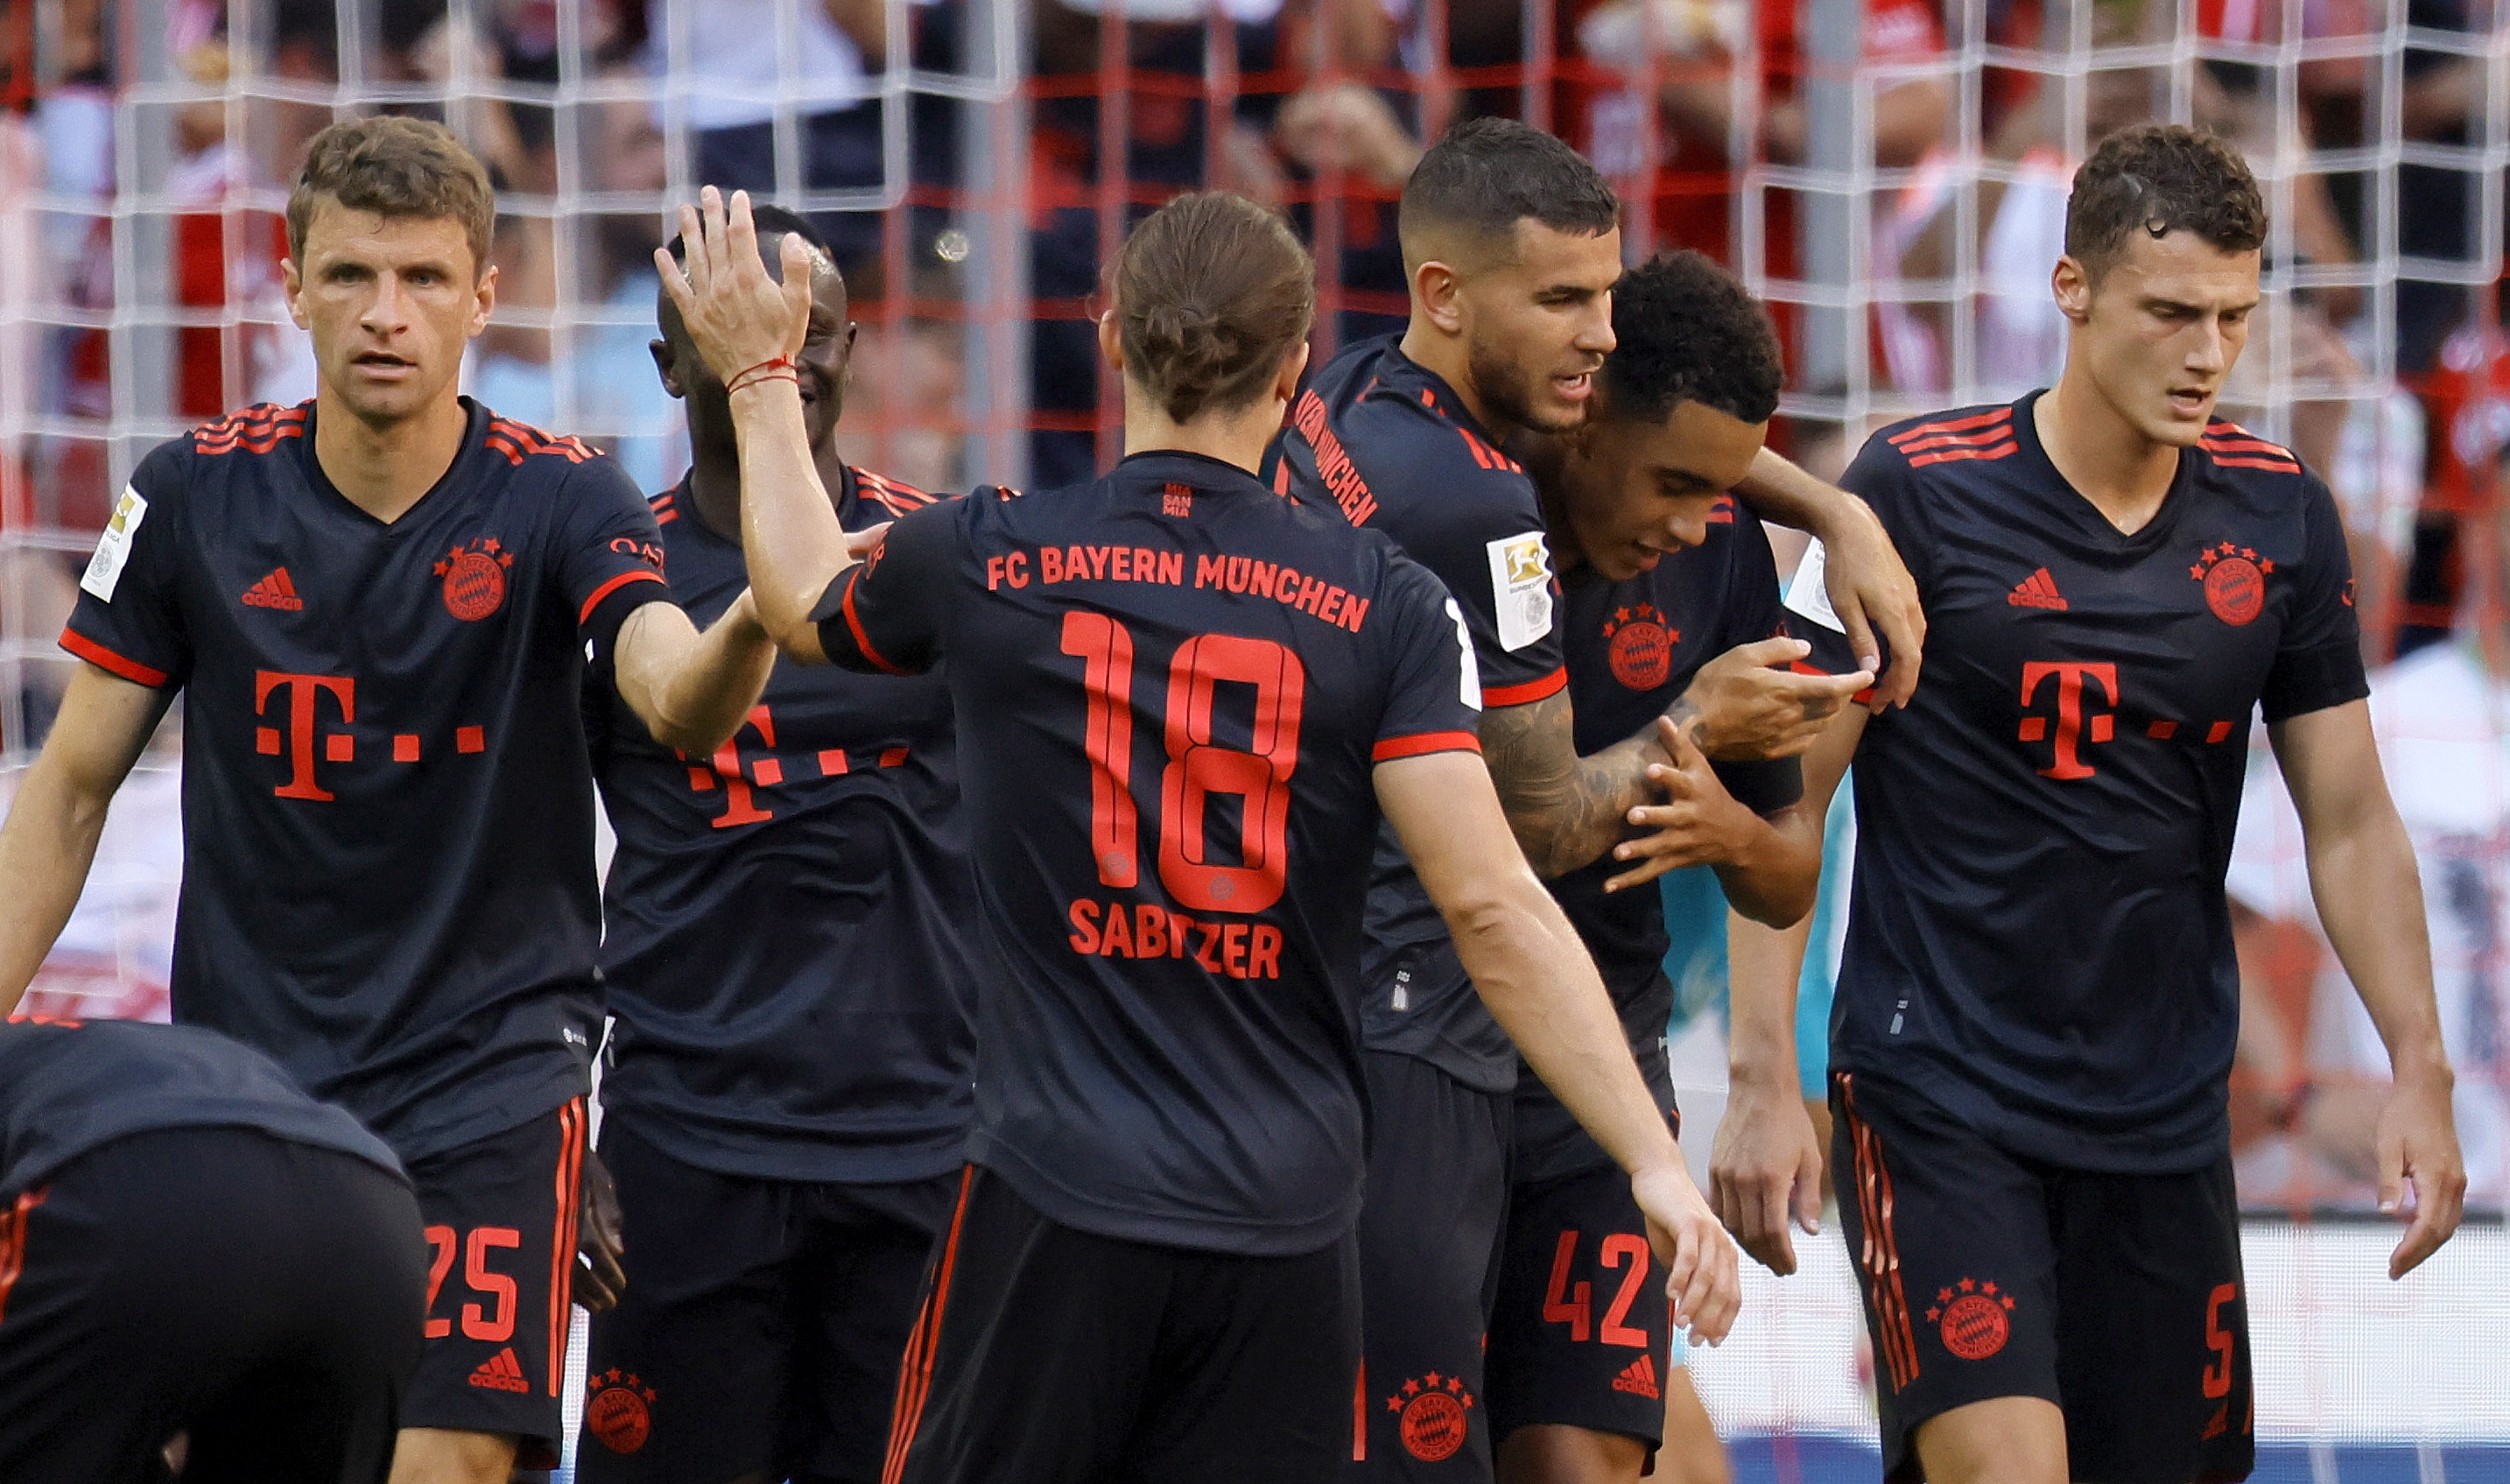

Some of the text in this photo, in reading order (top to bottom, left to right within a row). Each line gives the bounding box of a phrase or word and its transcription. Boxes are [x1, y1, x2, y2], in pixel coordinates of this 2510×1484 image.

[1295, 389, 1327, 447] YERN
[1163, 495, 1192, 508] SAN
[1163, 506, 1190, 518] MIA
[241, 591, 303, 611] adidas
[987, 545, 1371, 634] FC BAYERN MÜNCHEN
[2007, 591, 2069, 611] adidas
[256, 670, 355, 802] T
[1059, 609, 1305, 914] 18
[2019, 661, 2120, 780] T
[1069, 898, 1283, 980] SABITZER
[424, 1225, 521, 1342] 25
[1543, 1231, 1650, 1349] 42
[2203, 1283, 2235, 1398] 5
[468, 1372, 531, 1394] adidas
[1612, 1377, 1660, 1401] adidas
